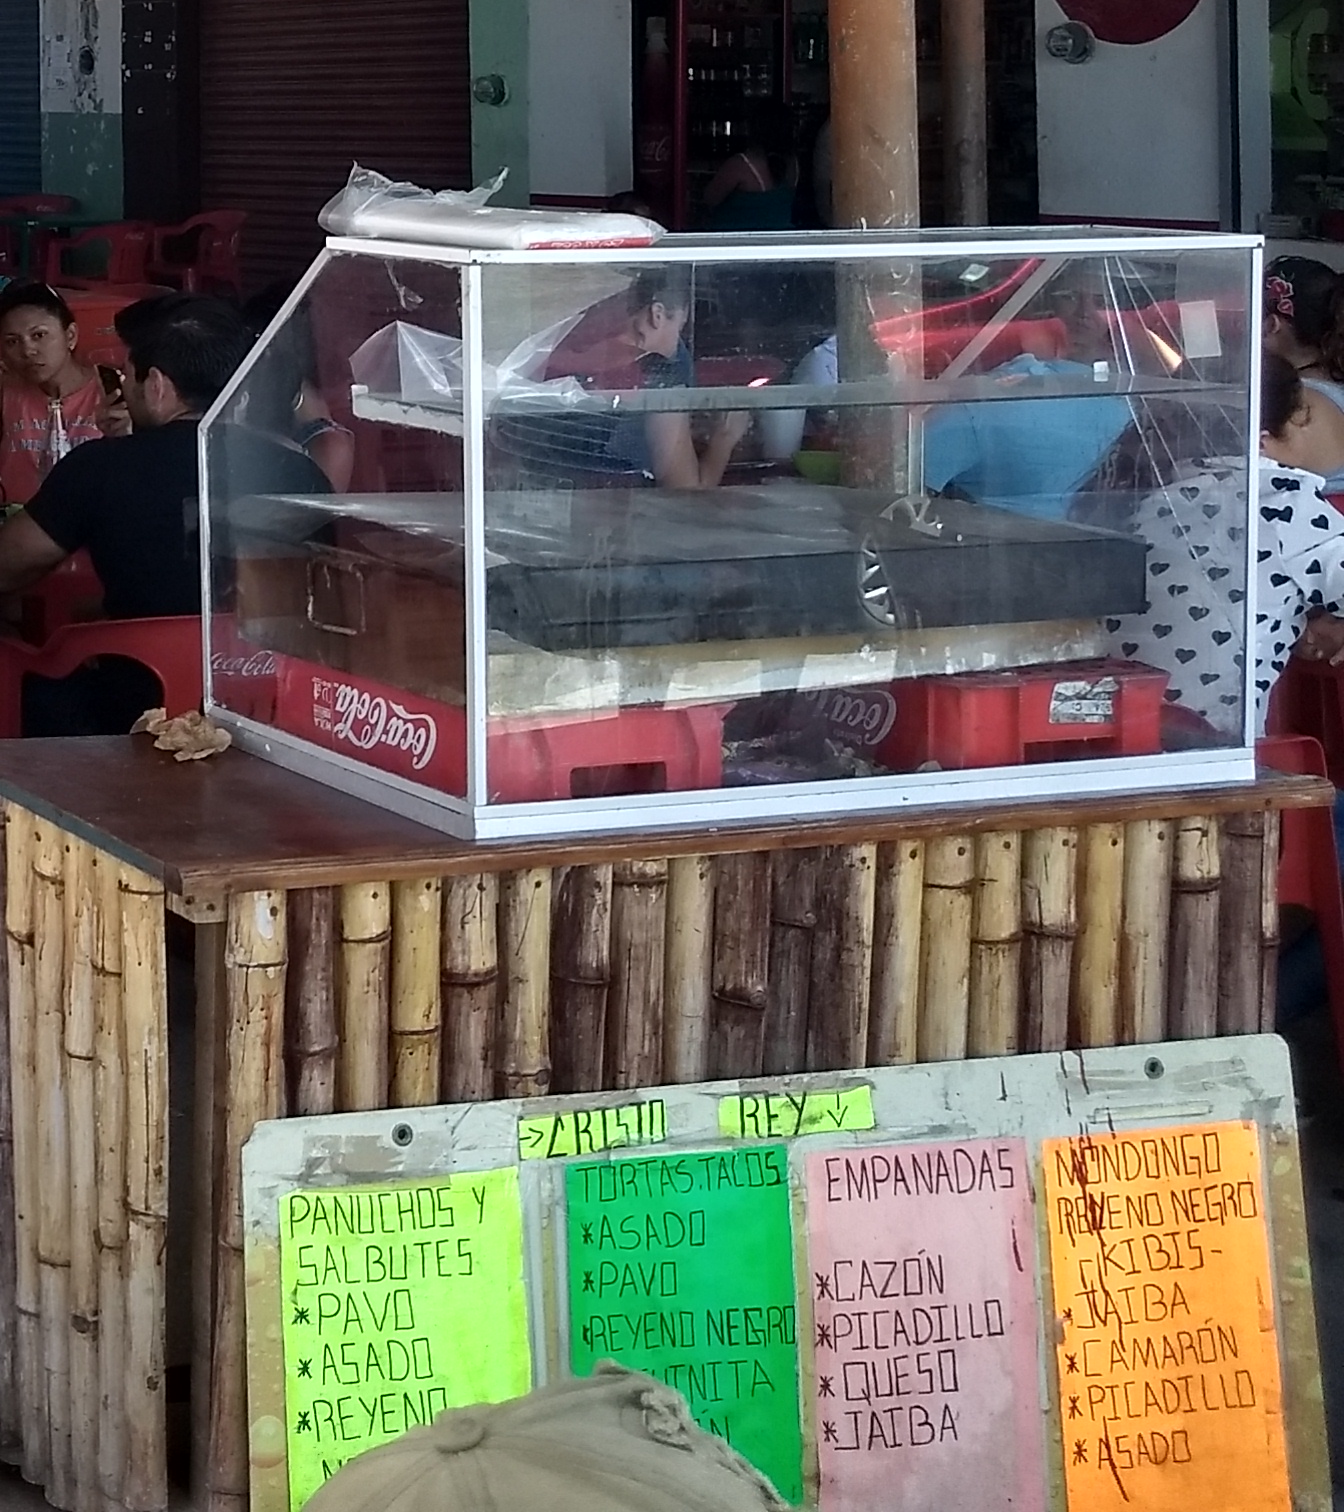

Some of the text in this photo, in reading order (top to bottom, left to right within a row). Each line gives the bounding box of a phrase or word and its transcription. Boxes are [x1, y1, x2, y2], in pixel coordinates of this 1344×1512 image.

[333, 683, 437, 770] Coca-Cola
[739, 1091, 807, 1139] REY
[824, 1148, 1015, 1202] EMPANADAS
[1055, 1132, 1223, 1188] MONDONGO
[289, 1186, 486, 1238] PANUCHOS Y
[1170, 1180, 1258, 1226] NEGRO
[599, 1209, 706, 1251] ASADO
[296, 1239, 473, 1287] SALBUTES
[599, 1261, 678, 1298] PAVO
[833, 1249, 945, 1302] CAZÓN
[318, 1289, 415, 1335] PAVO
[588, 1305, 797, 1353] REYENO NEGRO
[832, 1299, 1005, 1353] PICADILLO
[1075, 1280, 1191, 1330] JAIBA
[322, 1338, 434, 1385] ASADO
[1083, 1317, 1239, 1378] CAMARÓN
[842, 1349, 960, 1406] QUESO
[1087, 1369, 1257, 1422] PICADILLO
[834, 1403, 959, 1451] JAIBA
[1098, 1430, 1193, 1470] ASADO
